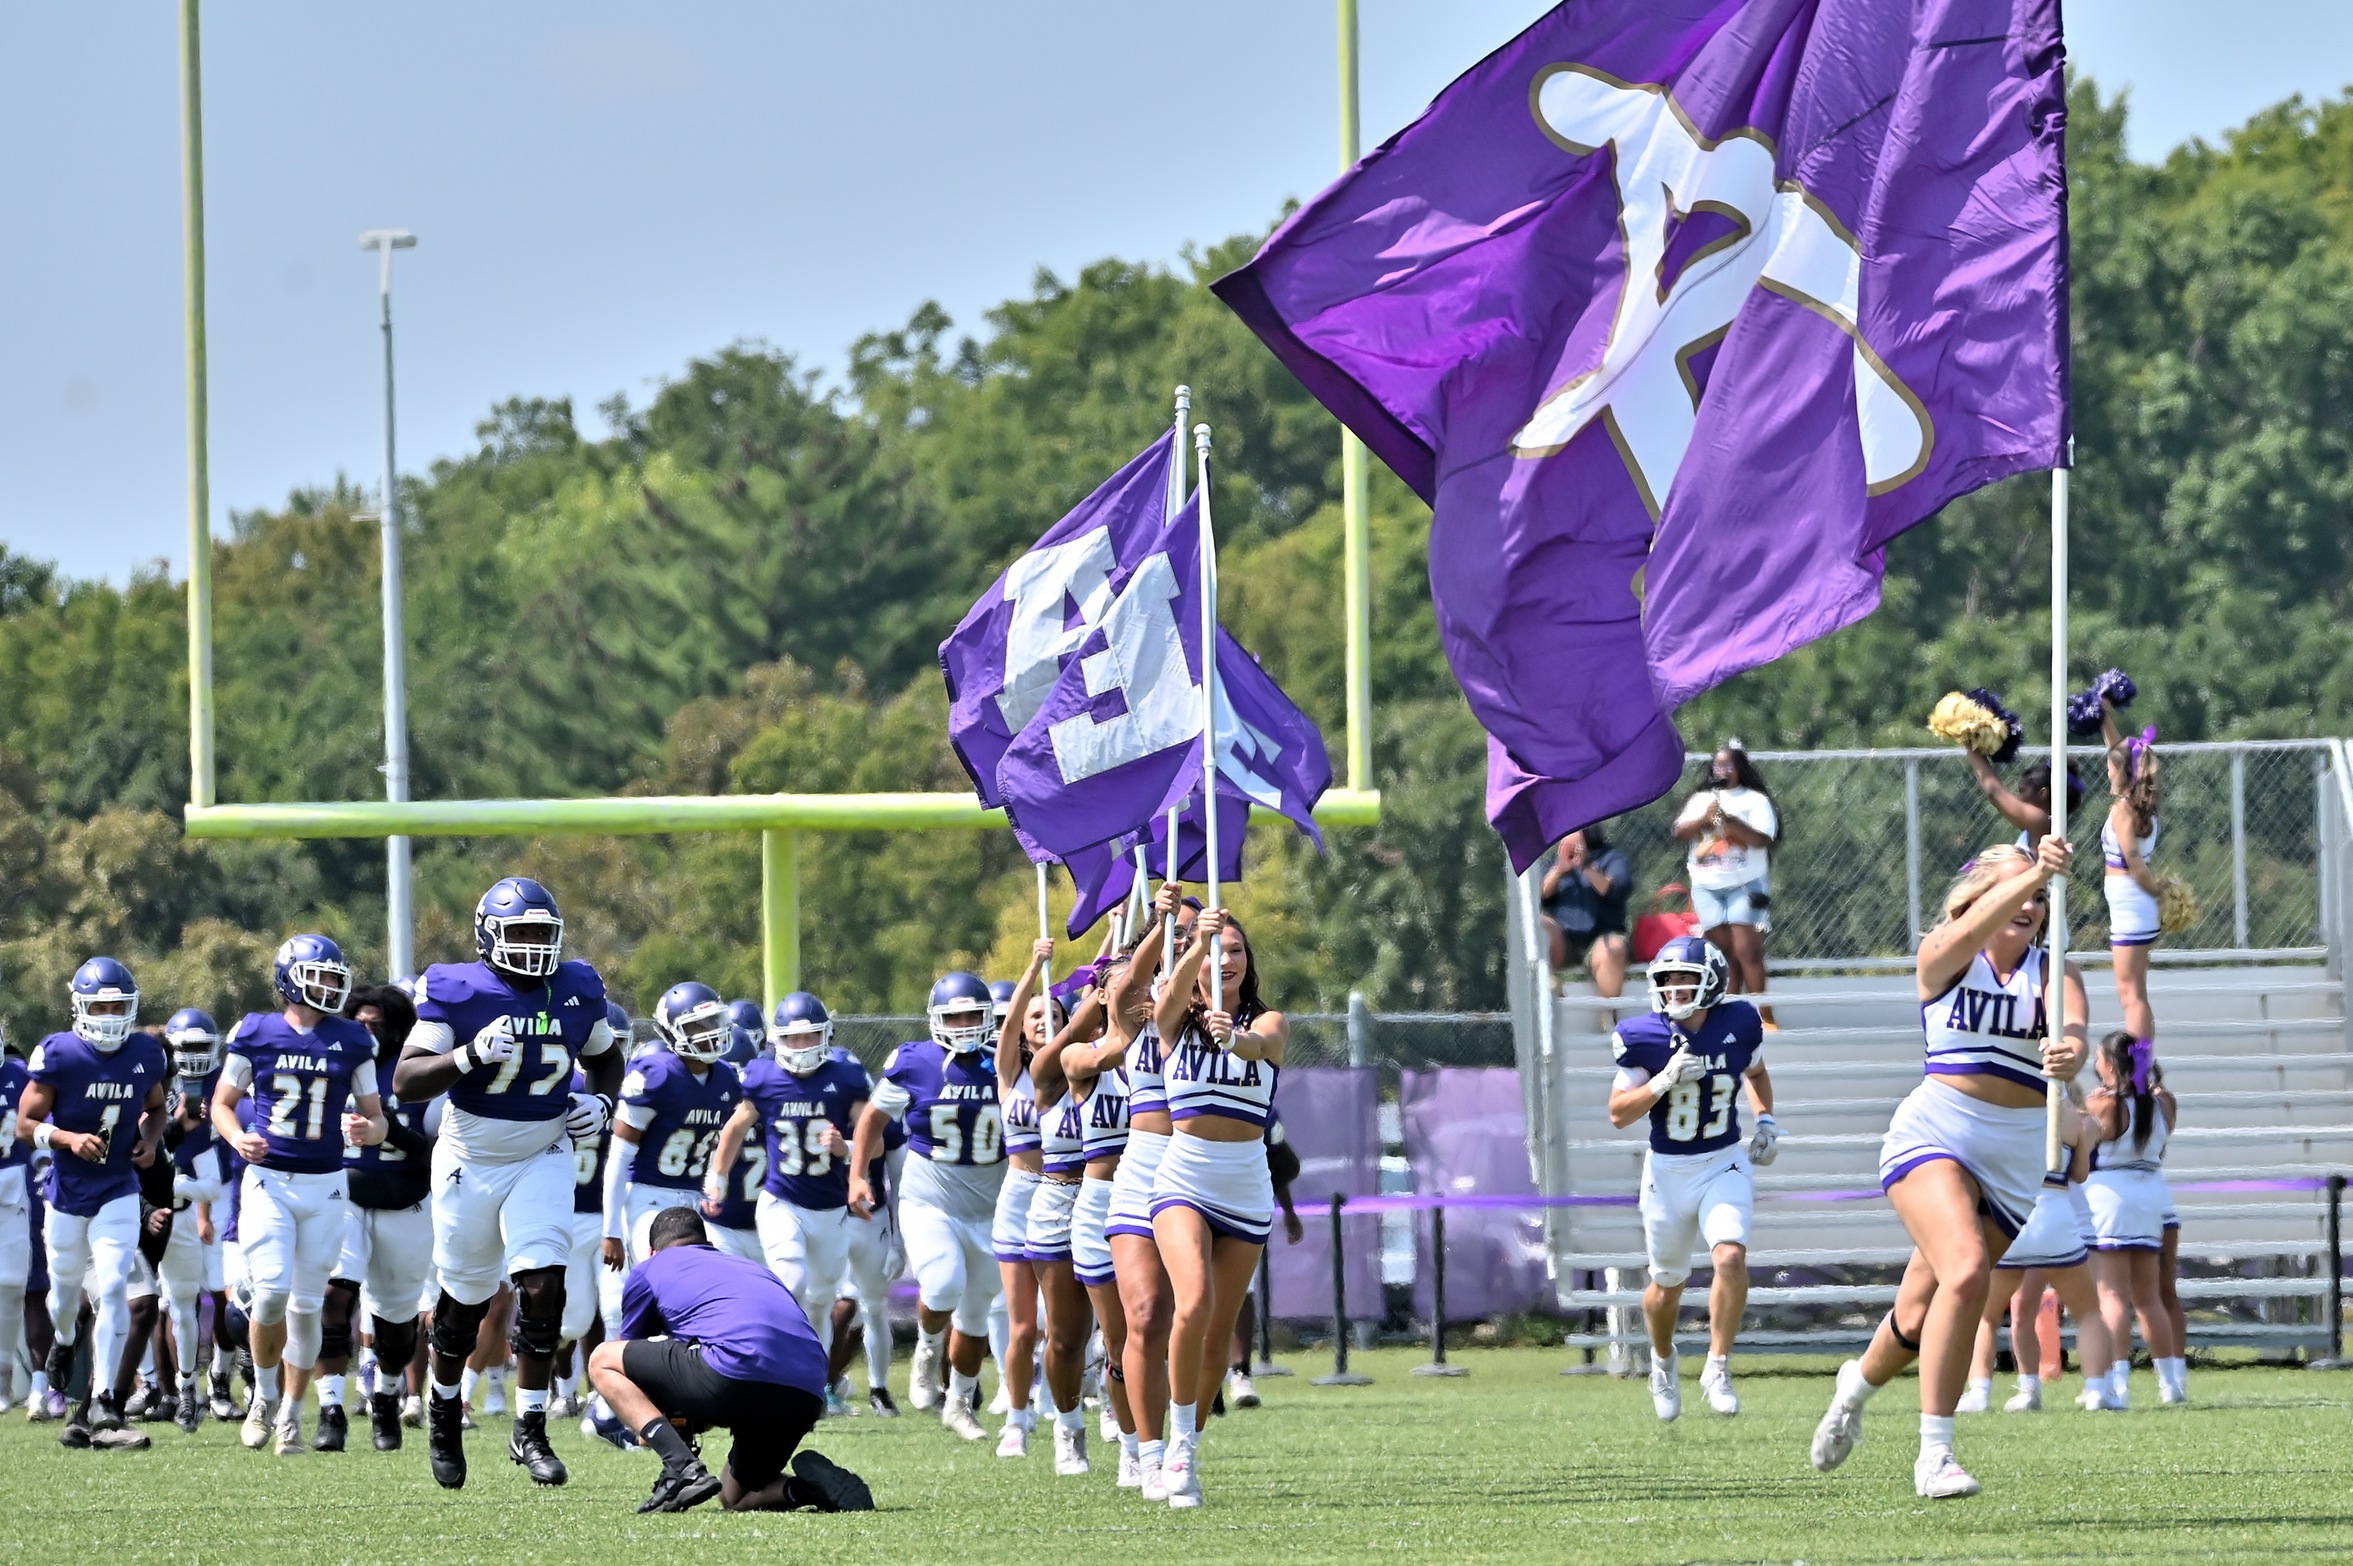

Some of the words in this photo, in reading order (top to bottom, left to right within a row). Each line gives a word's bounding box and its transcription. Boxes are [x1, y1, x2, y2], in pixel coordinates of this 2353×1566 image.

[1946, 986, 2048, 1041] AVILA
[275, 1054, 328, 1073] AVILA
[1173, 1043, 1262, 1087] AVILA
[84, 1083, 135, 1099] AVILA
[939, 1085, 993, 1100] AVILA
[267, 1073, 329, 1141] 21
[684, 1109, 721, 1125] AVILA
[781, 1102, 826, 1118] AVILA
[1666, 1073, 1735, 1142] 83
[929, 1104, 1004, 1165] 50
